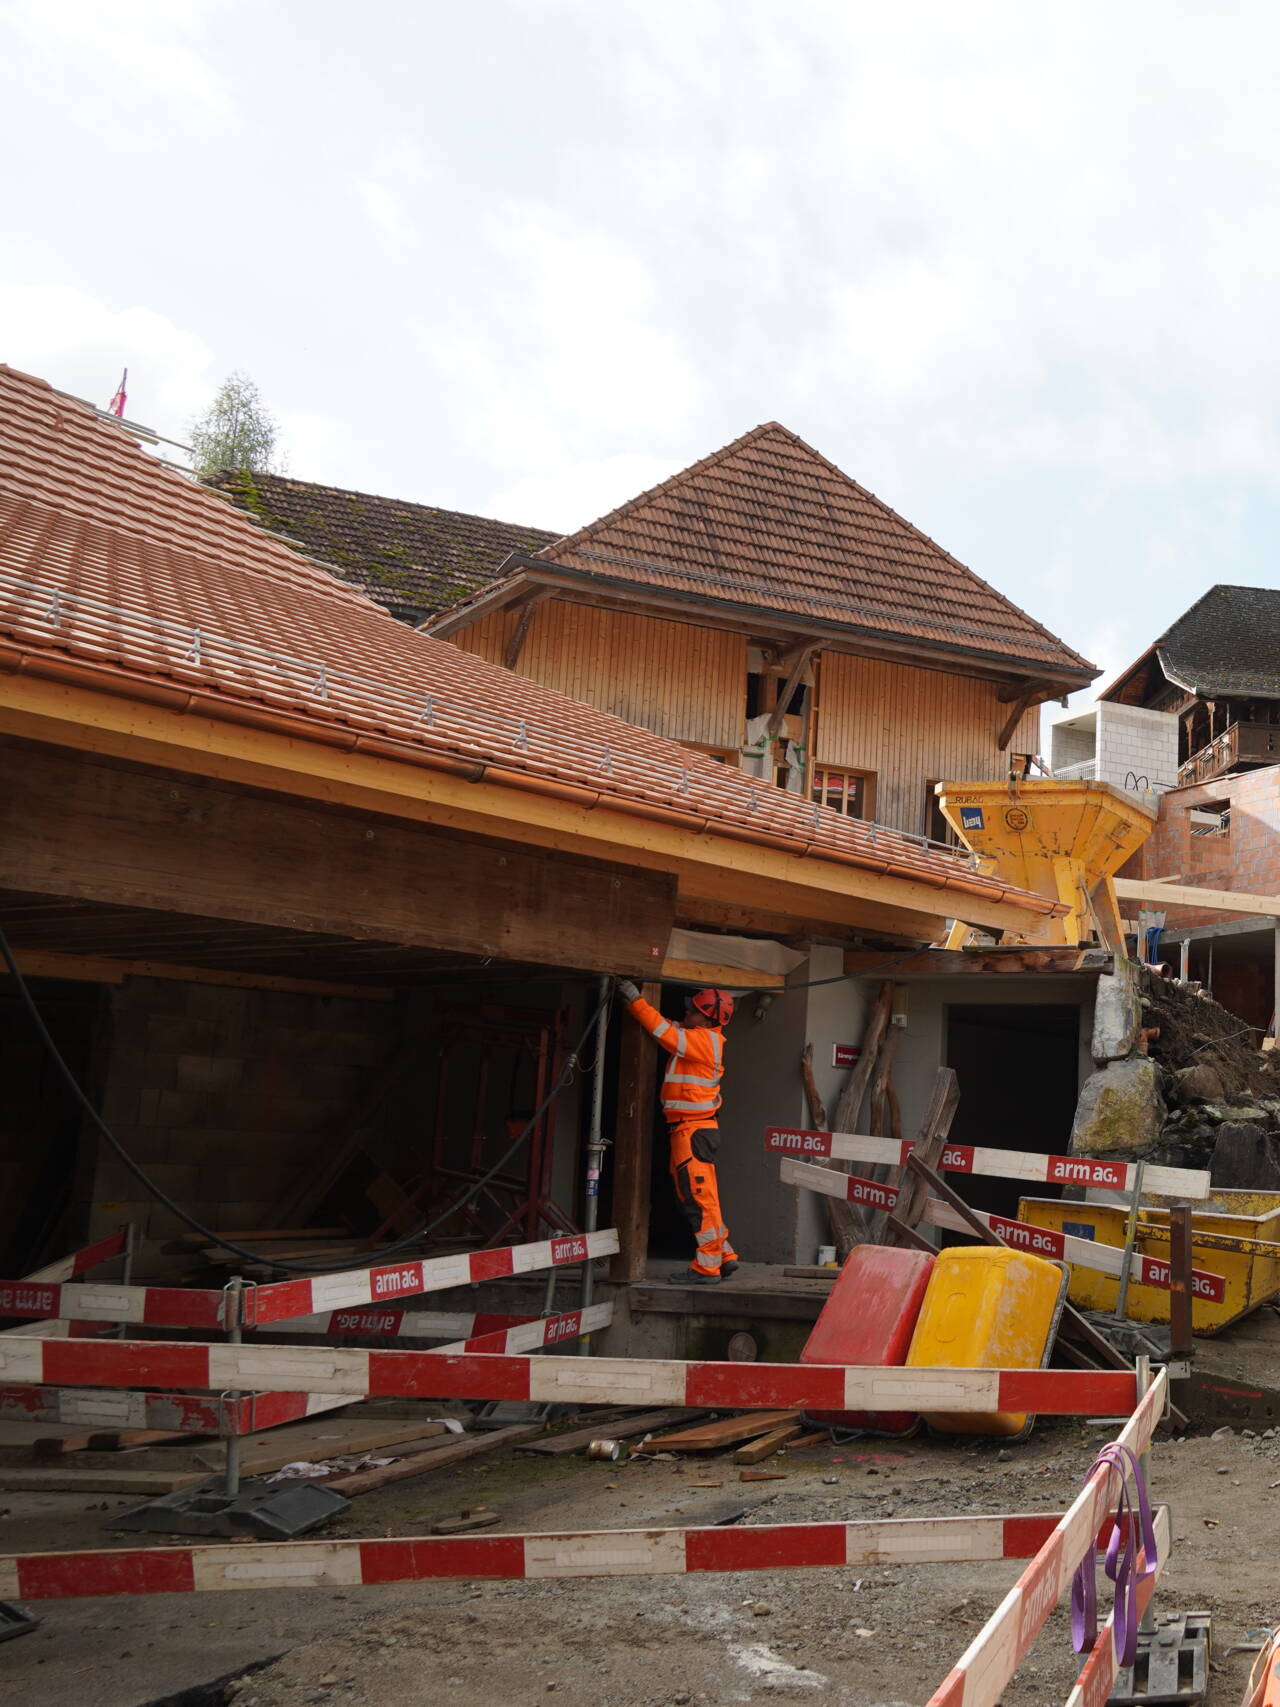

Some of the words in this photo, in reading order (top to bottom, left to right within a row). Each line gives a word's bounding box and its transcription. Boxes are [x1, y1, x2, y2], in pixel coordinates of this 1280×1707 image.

[770, 1131, 802, 1149] arm
[1054, 1161, 1090, 1180] arm
[853, 1183, 886, 1204] arm
[995, 1223, 1031, 1245] arm
[375, 1271, 400, 1293] arm
[1149, 1264, 1171, 1283] ar
